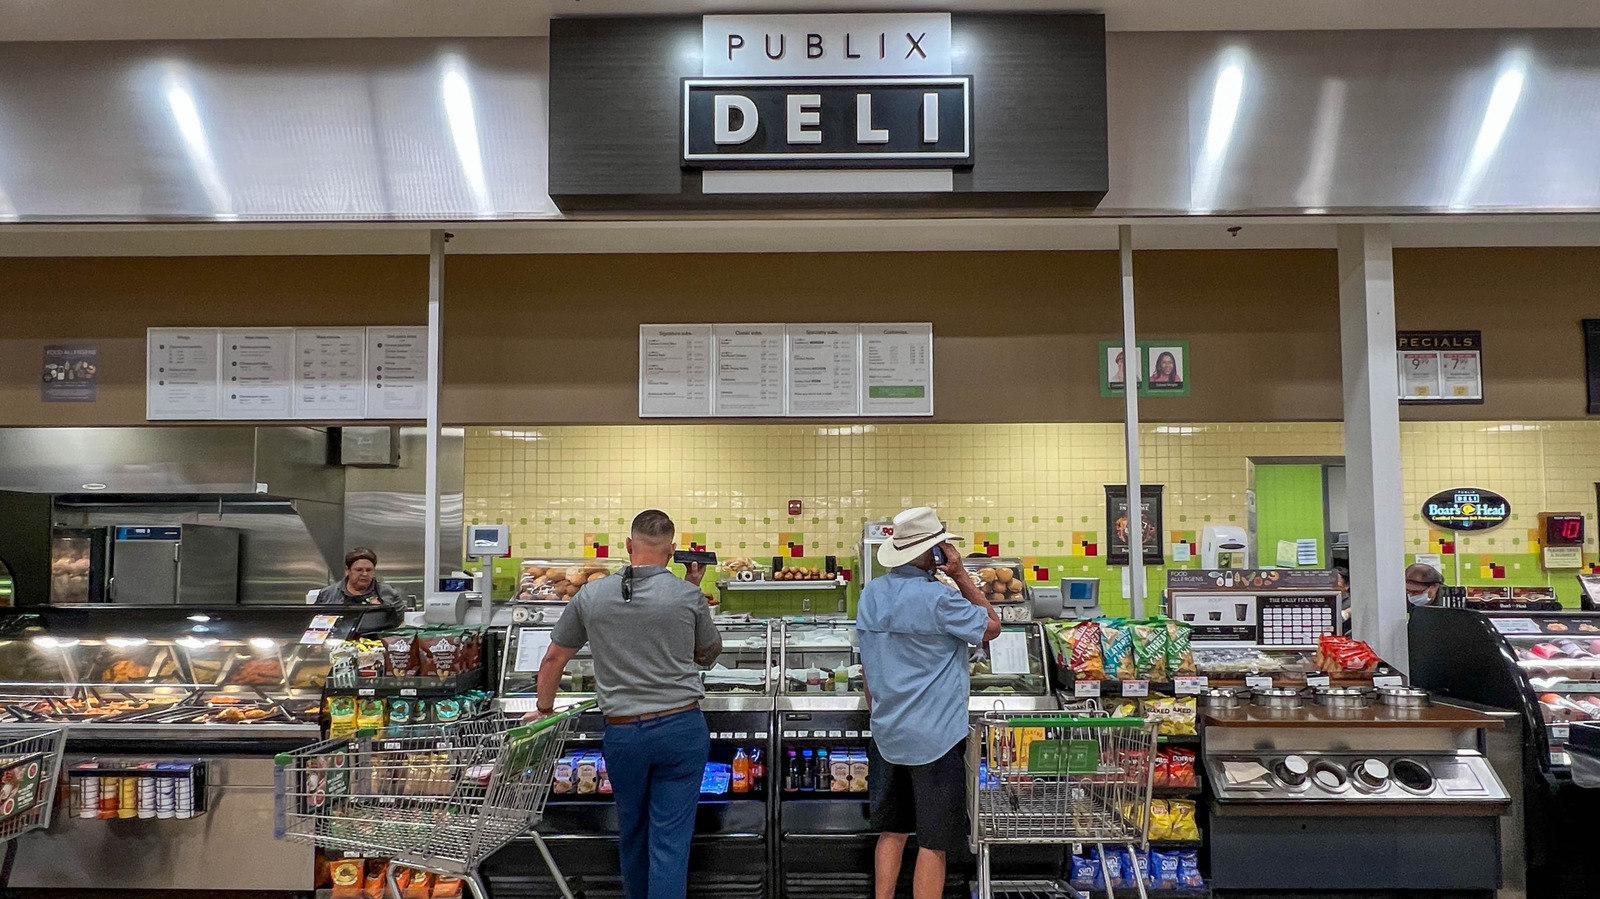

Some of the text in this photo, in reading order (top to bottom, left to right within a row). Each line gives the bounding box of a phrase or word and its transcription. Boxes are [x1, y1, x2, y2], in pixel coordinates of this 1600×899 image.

[728, 32, 926, 60] PUBLIX
[714, 93, 940, 146] DELI
[1399, 337, 1473, 347] PECIALS
[1428, 503, 1506, 516] Boar's Head
[1562, 521, 1580, 538] 10
